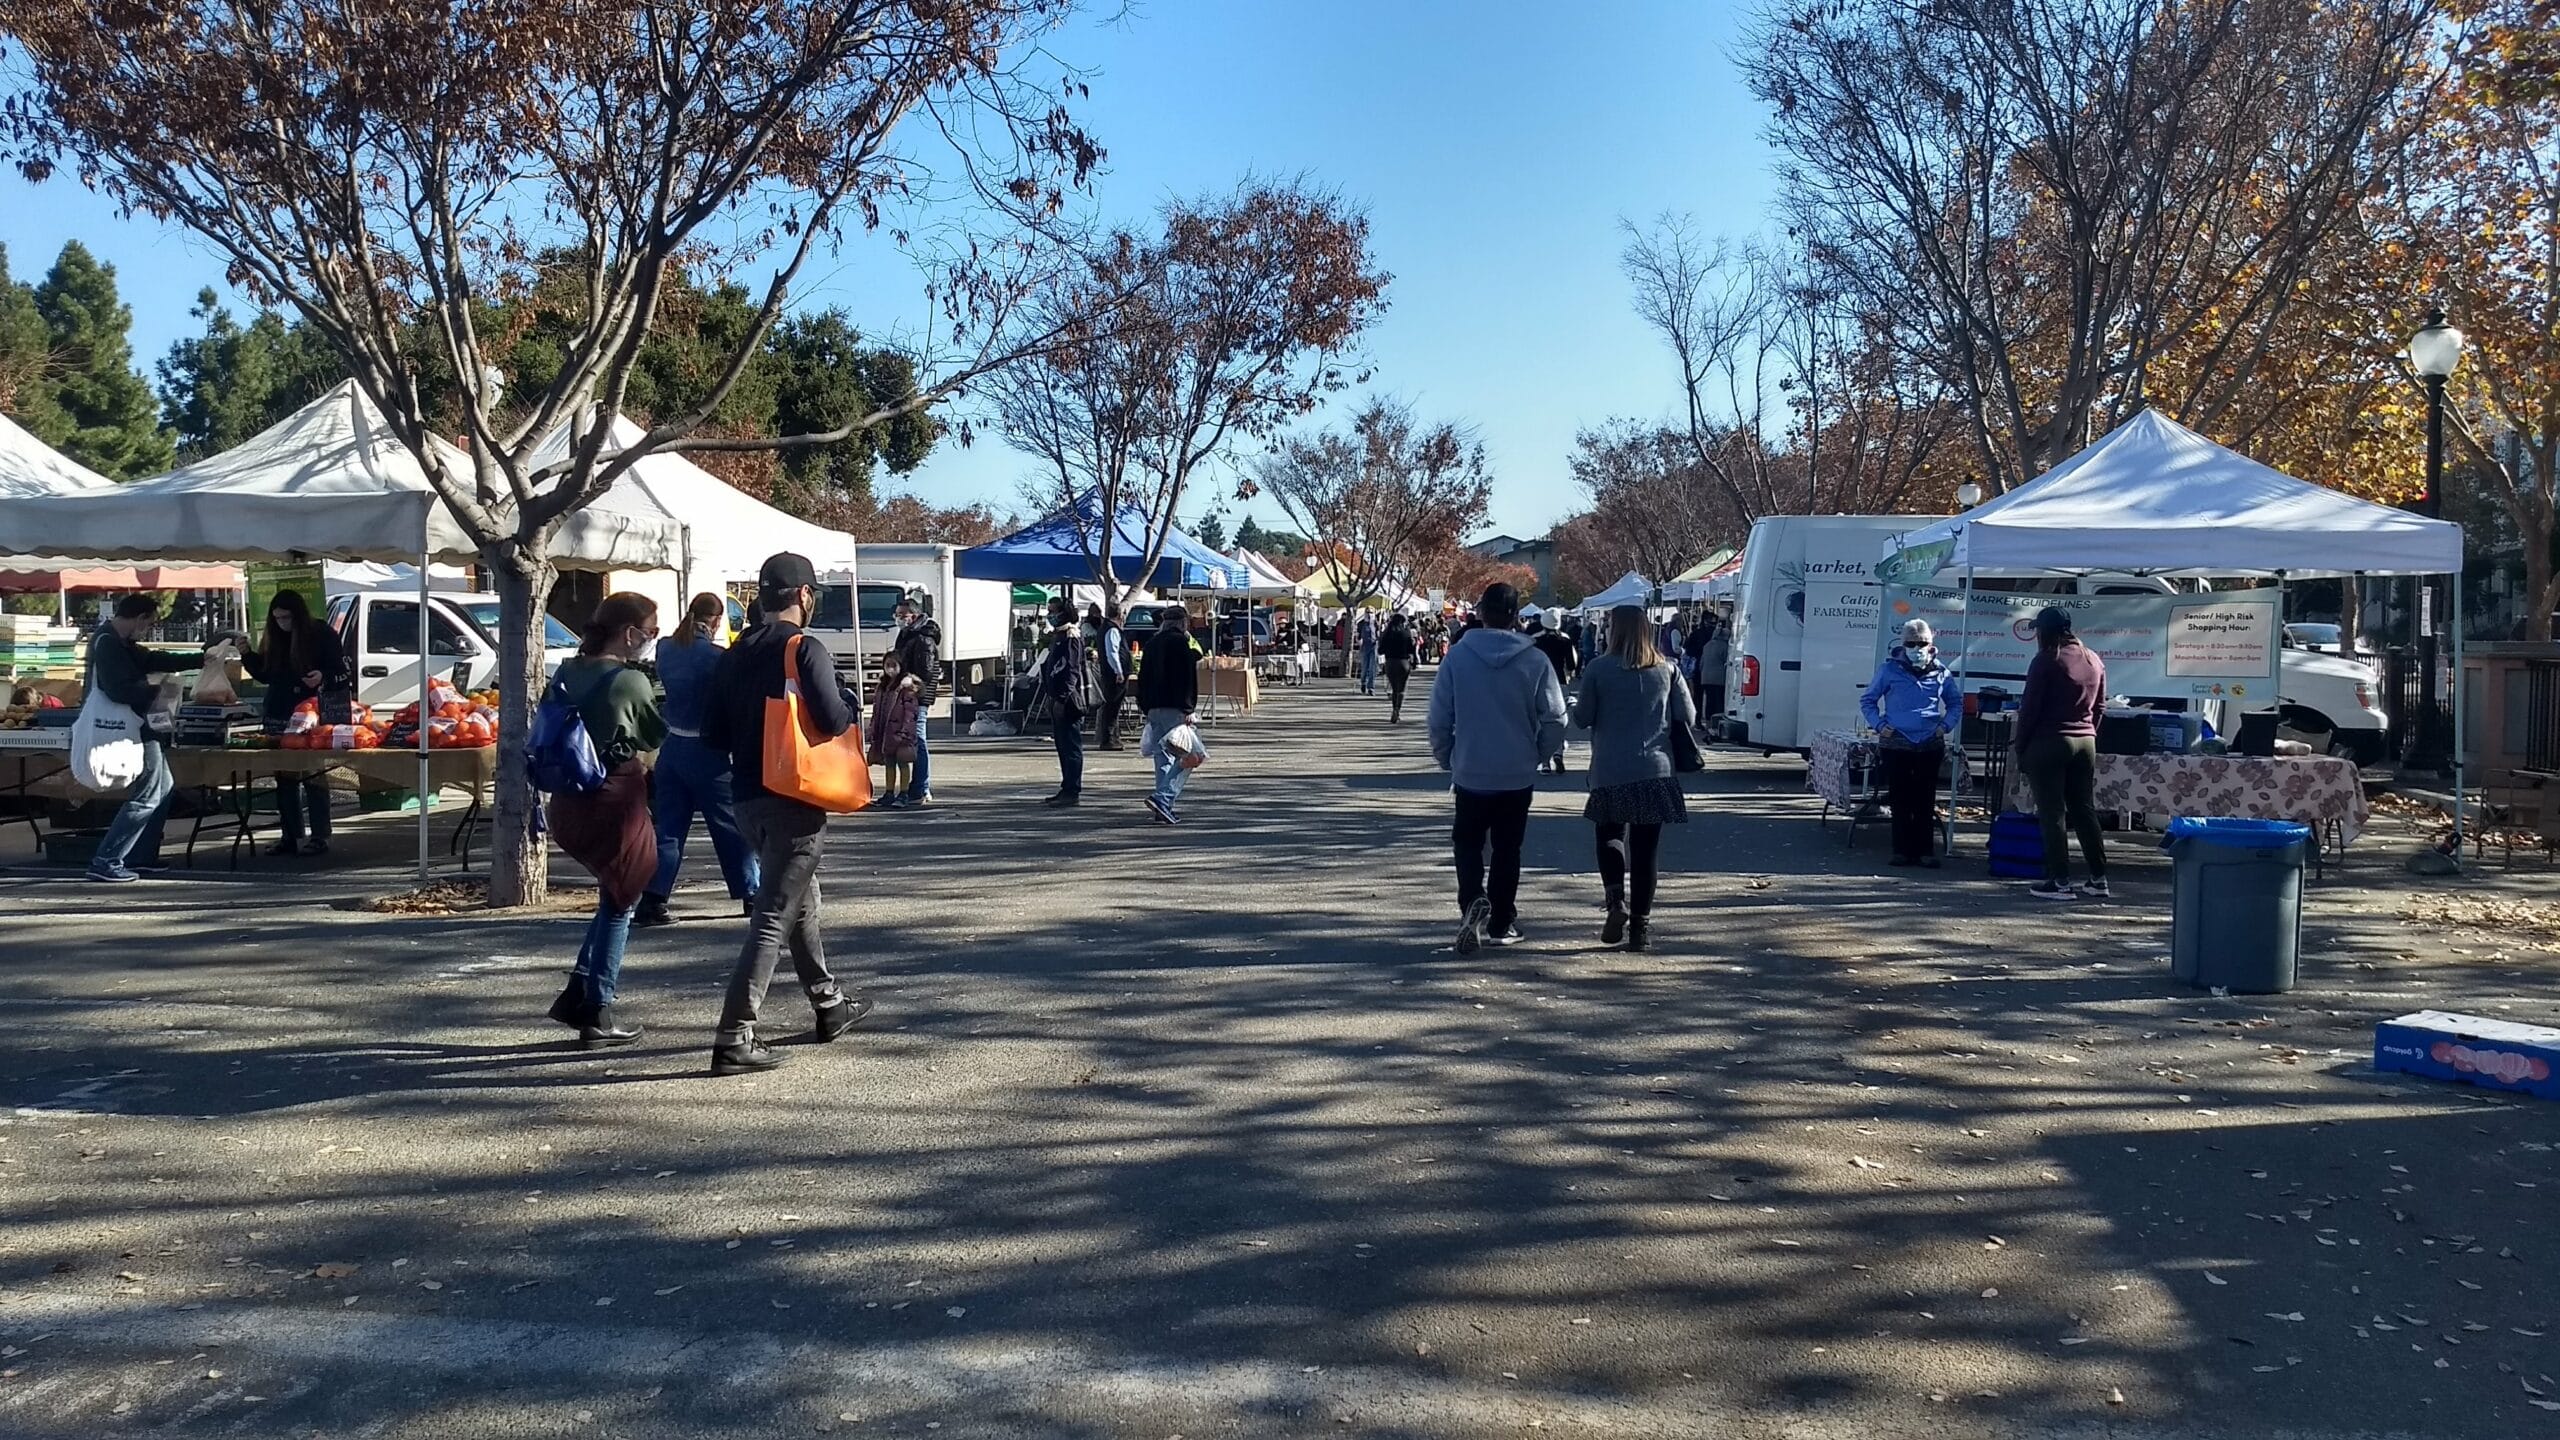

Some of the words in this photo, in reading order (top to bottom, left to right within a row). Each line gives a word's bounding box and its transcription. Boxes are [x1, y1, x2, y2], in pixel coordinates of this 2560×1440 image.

[1970, 594, 2020, 606] MARKET
[2021, 598, 2091, 609] GUIDELINES
[2184, 613, 2214, 621] Senior/
[2215, 612, 2235, 622] High
[2237, 612, 2254, 620] Risk
[2187, 623, 2227, 632] Shopping
[1940, 649, 1976, 657] distace
